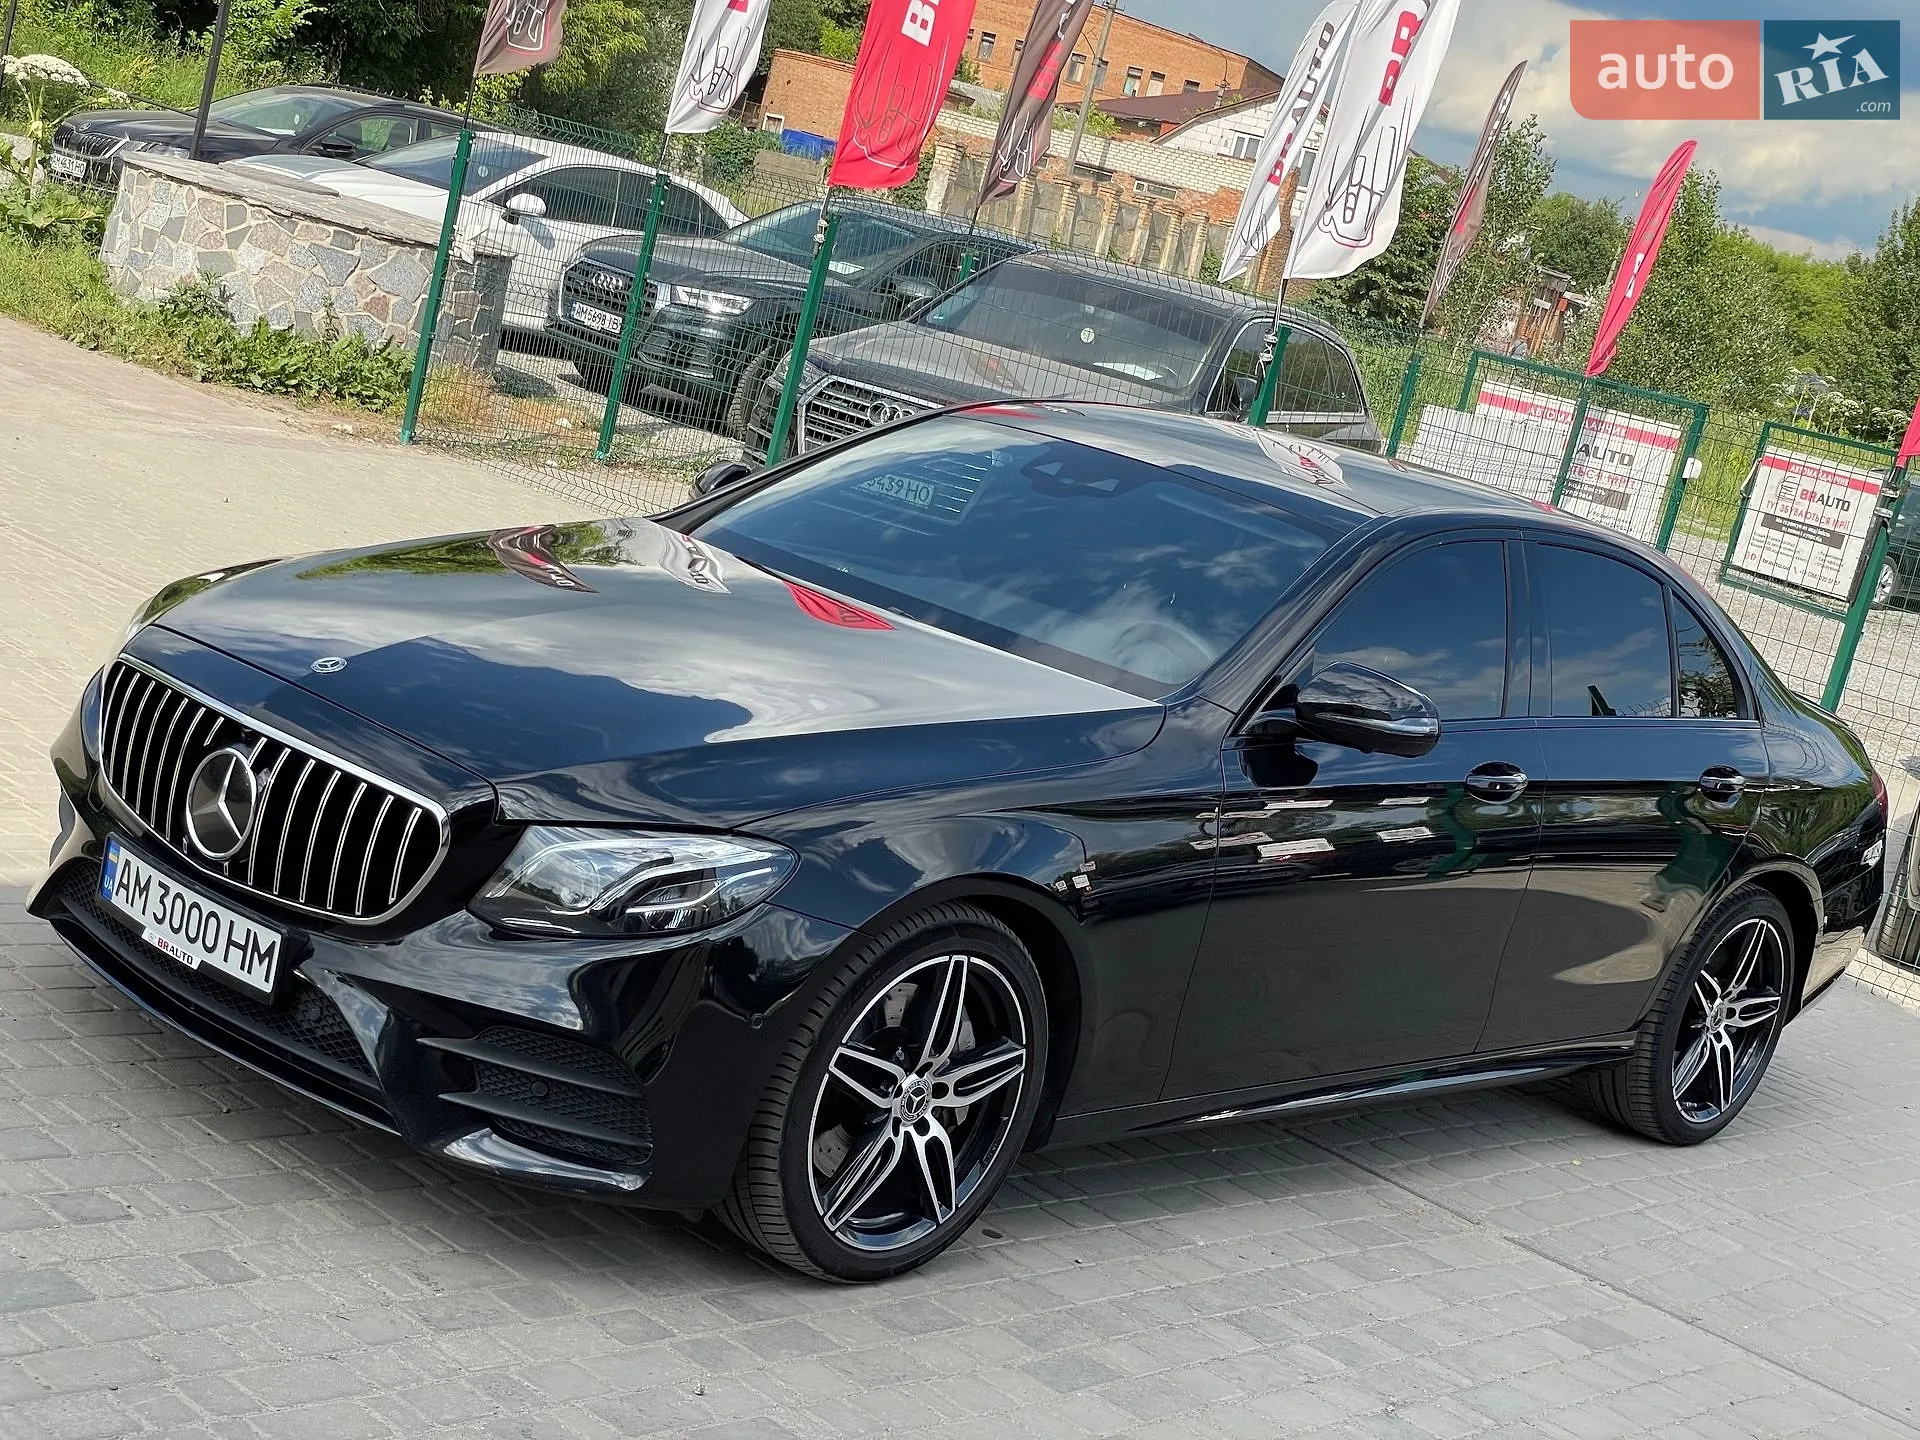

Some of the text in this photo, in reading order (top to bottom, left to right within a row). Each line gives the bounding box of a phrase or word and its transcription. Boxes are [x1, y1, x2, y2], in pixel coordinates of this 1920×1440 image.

[901, 0, 940, 47] B
[1378, 0, 1430, 107] BR
[576, 304, 588, 320] AM
[1573, 442, 1634, 468] AUTO
[1800, 488, 1851, 512] BRAUTO
[104, 877, 113, 892] UA
[115, 858, 277, 984] AM 3000 HM
[157, 936, 194, 967] BRAUTO
